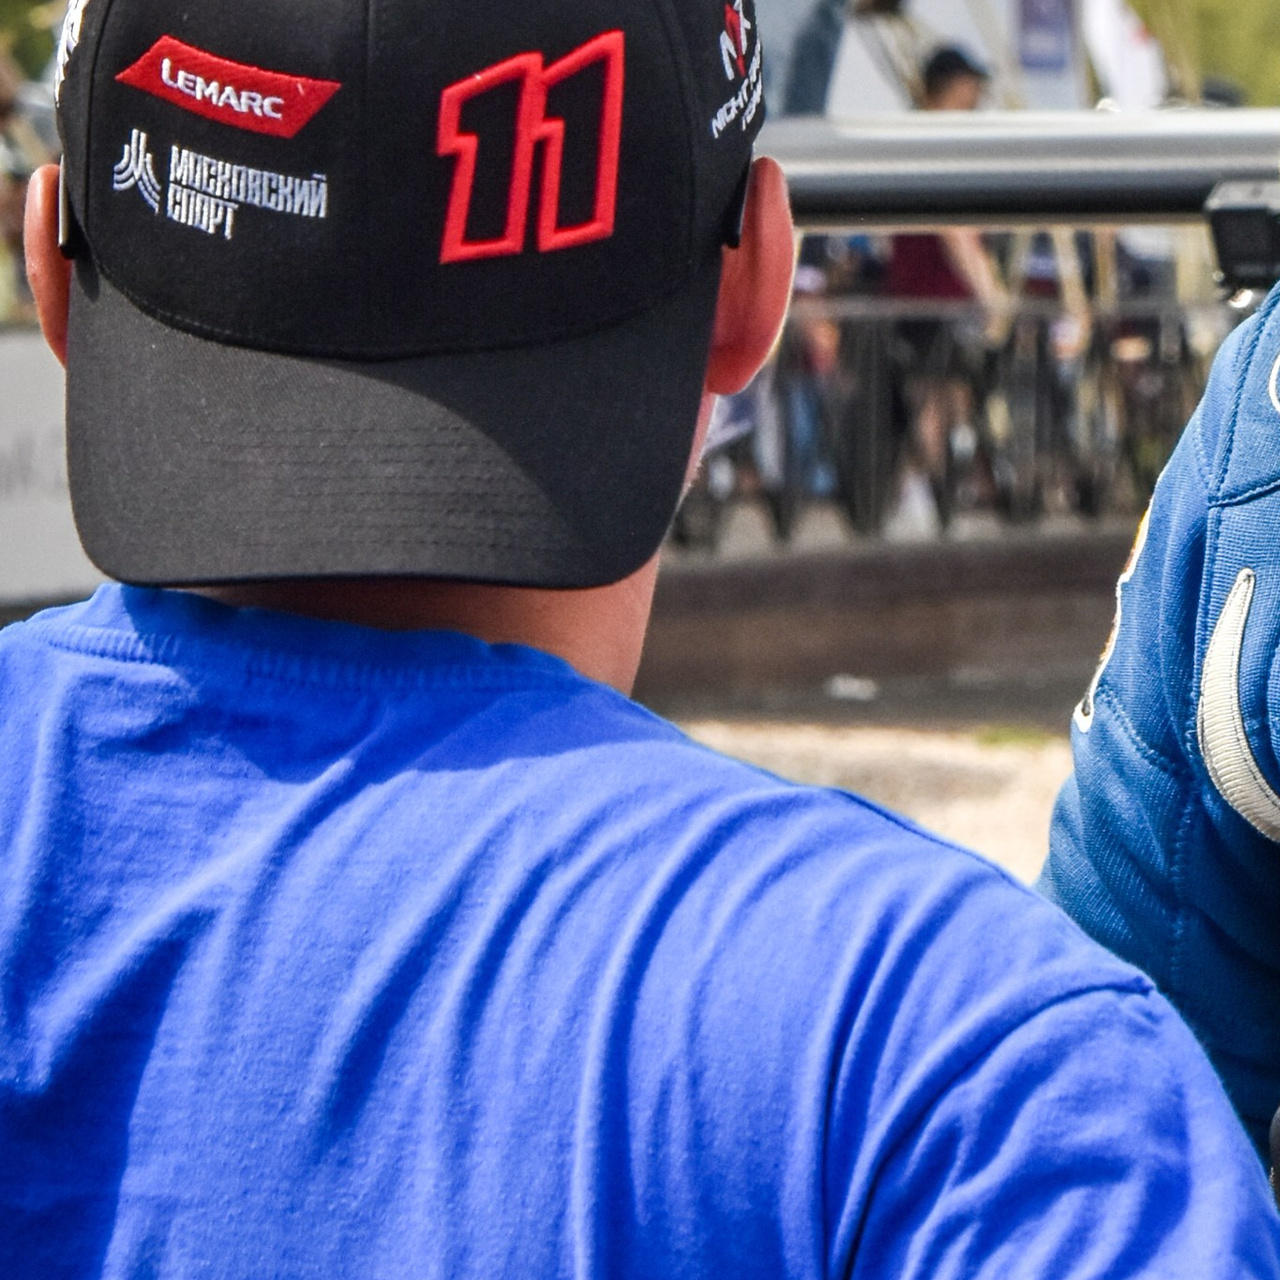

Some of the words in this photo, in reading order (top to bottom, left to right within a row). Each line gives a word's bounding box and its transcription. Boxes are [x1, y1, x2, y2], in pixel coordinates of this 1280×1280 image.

[161, 57, 285, 120] LEMARC
[169, 144, 327, 218] МОСКОВСКИЙ
[437, 29, 625, 265] 11
[167, 183, 239, 240] СПОРТ
